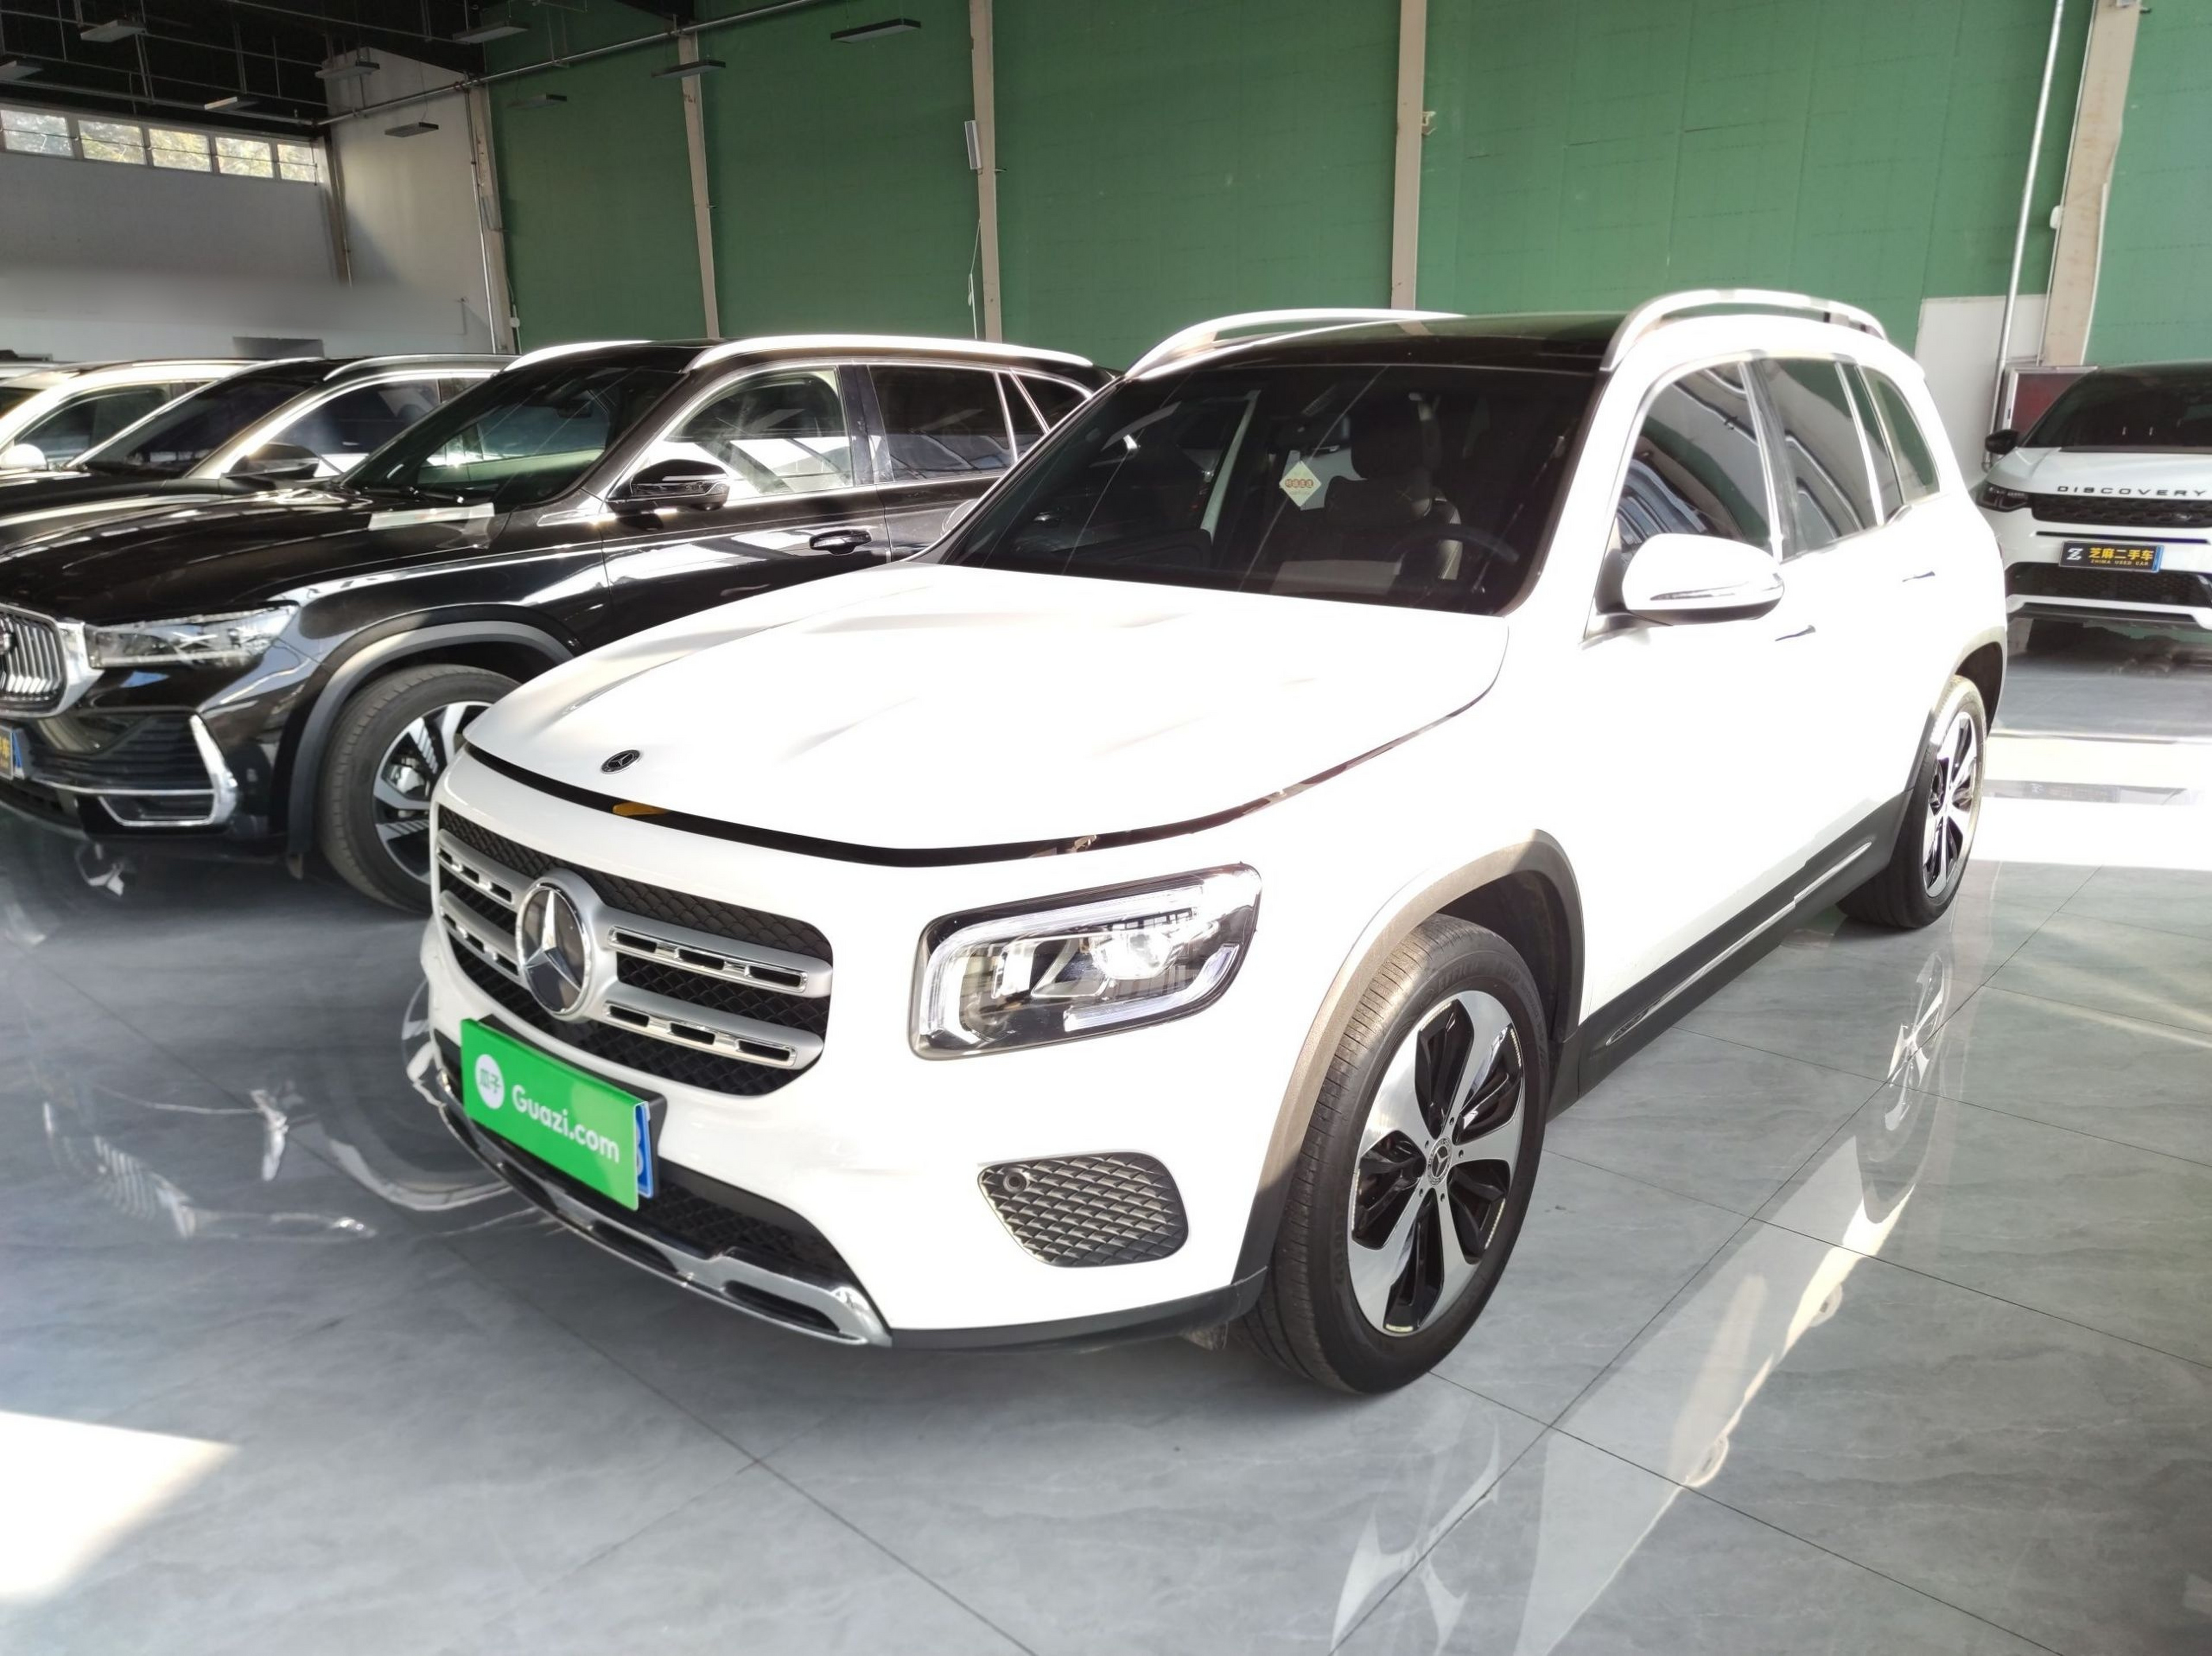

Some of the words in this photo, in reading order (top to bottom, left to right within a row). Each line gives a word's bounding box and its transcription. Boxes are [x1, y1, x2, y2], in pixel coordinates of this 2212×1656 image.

[2057, 485, 2206, 497] DISCOVERY
[2089, 547, 2154, 561] 芝麻二手车
[512, 1084, 620, 1164] Guazi.com
